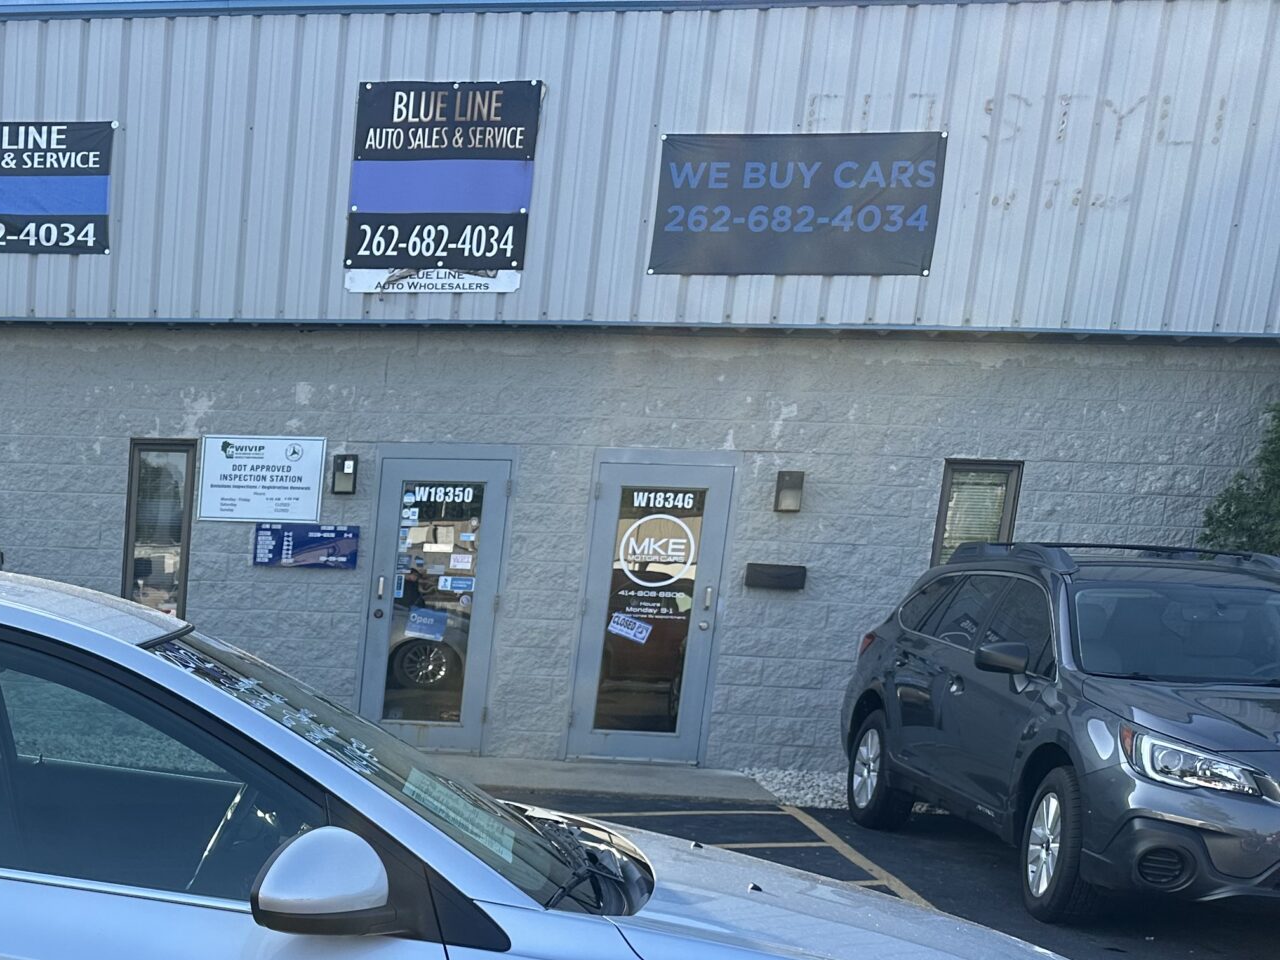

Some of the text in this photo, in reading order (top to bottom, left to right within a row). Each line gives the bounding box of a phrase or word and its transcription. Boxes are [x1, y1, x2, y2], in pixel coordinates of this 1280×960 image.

[392, 90, 504, 123] BLUE LINE
[1, 125, 67, 150] LINE
[365, 127, 525, 150] AUTO SALES & SERVICE
[0, 152, 17, 169] &
[22, 151, 100, 169] SERVICE
[670, 160, 937, 189] WE BUY CARS
[664, 204, 930, 233] 262-682-4034
[357, 224, 514, 258] 262-682-4034
[436, 270, 465, 280] LINE
[232, 464, 292, 473] DOT APPROVED
[219, 474, 303, 483] INSPECTION STATION
[415, 486, 473, 503] W18350
[633, 492, 694, 509] W18346
[628, 537, 687, 556] MKE
[625, 606, 658, 614] Monday
[410, 613, 435, 625] Open
[612, 615, 637, 631] CLOSED
